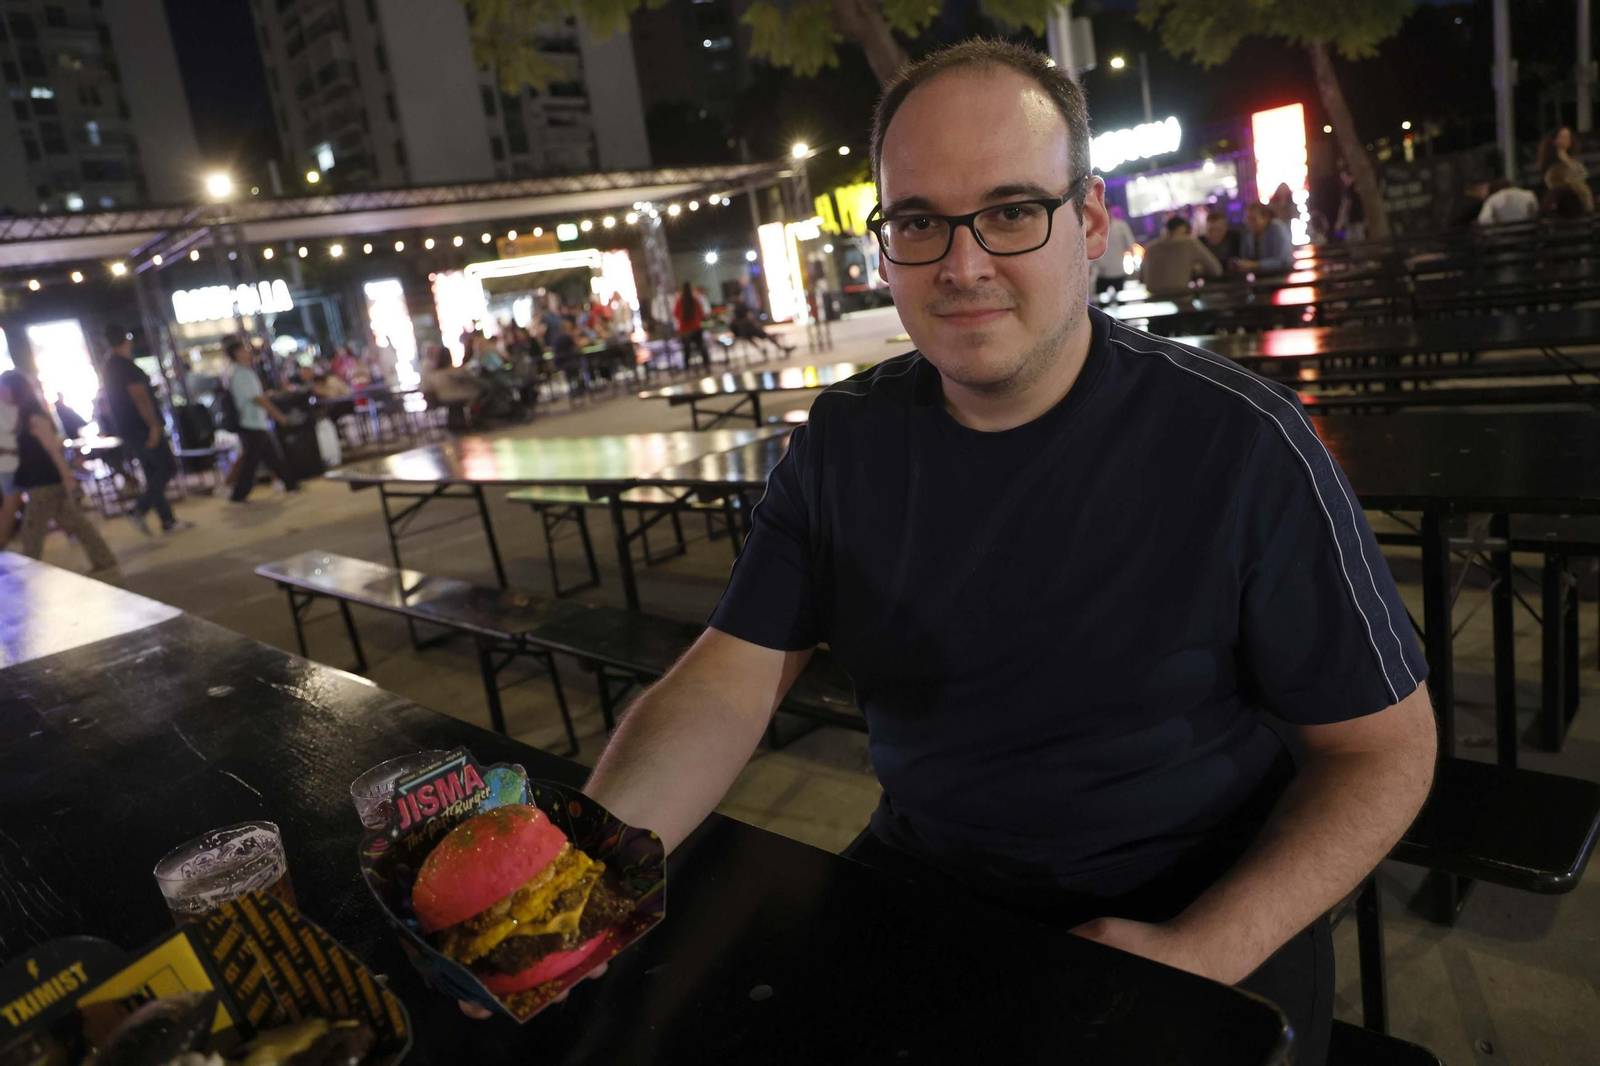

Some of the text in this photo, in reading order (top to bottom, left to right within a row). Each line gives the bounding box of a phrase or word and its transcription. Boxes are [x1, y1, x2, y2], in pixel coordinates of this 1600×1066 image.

[397, 764, 485, 829] JISMA
[404, 831, 424, 852] The
[449, 787, 491, 819] Burger
